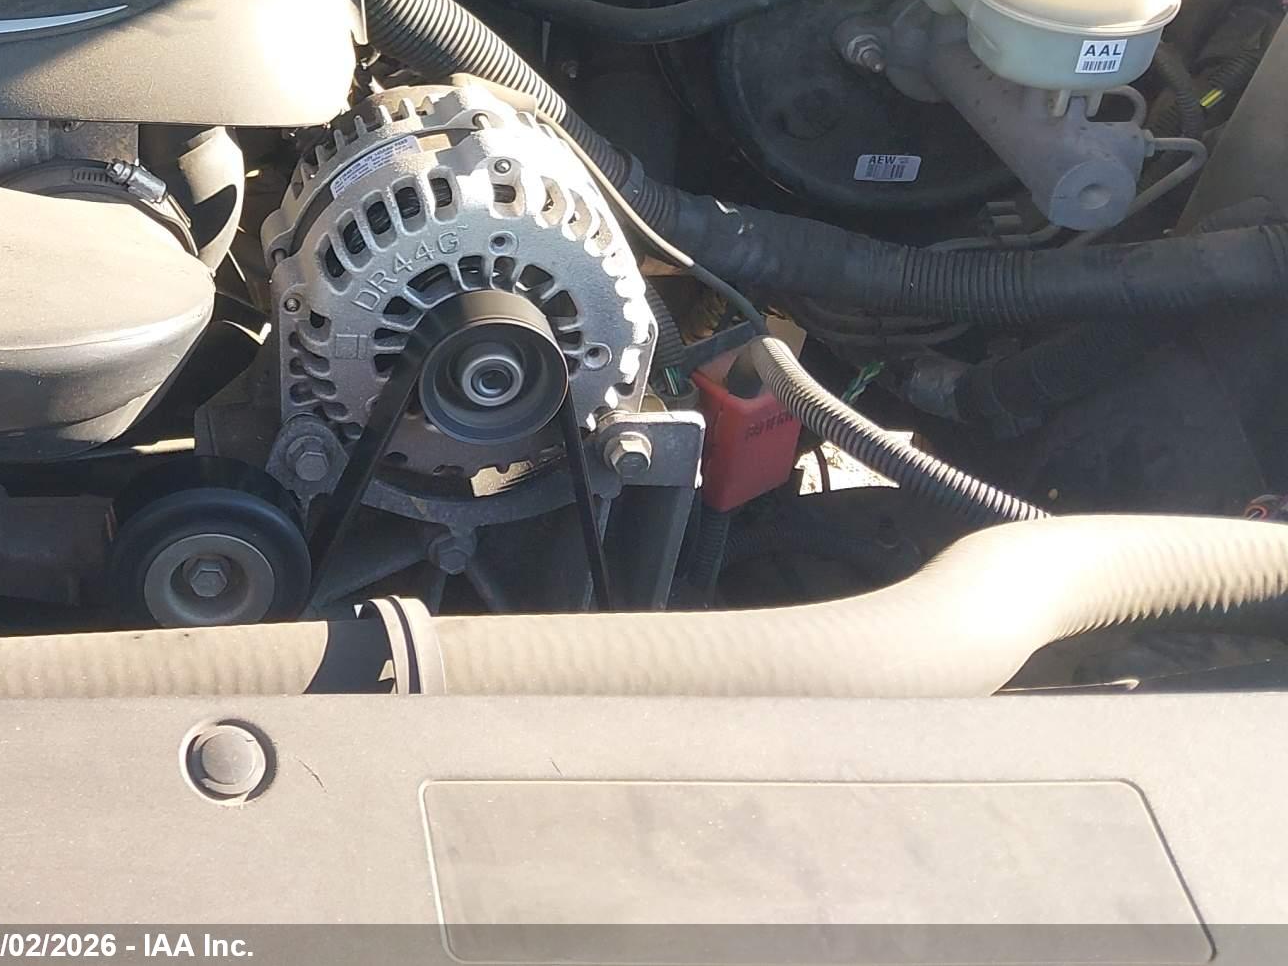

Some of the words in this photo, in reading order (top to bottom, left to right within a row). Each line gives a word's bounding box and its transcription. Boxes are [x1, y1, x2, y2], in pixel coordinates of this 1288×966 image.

[1083, 43, 1122, 57] AAL
[868, 155, 897, 165] AEW
[351, 231, 460, 312] DR44G
